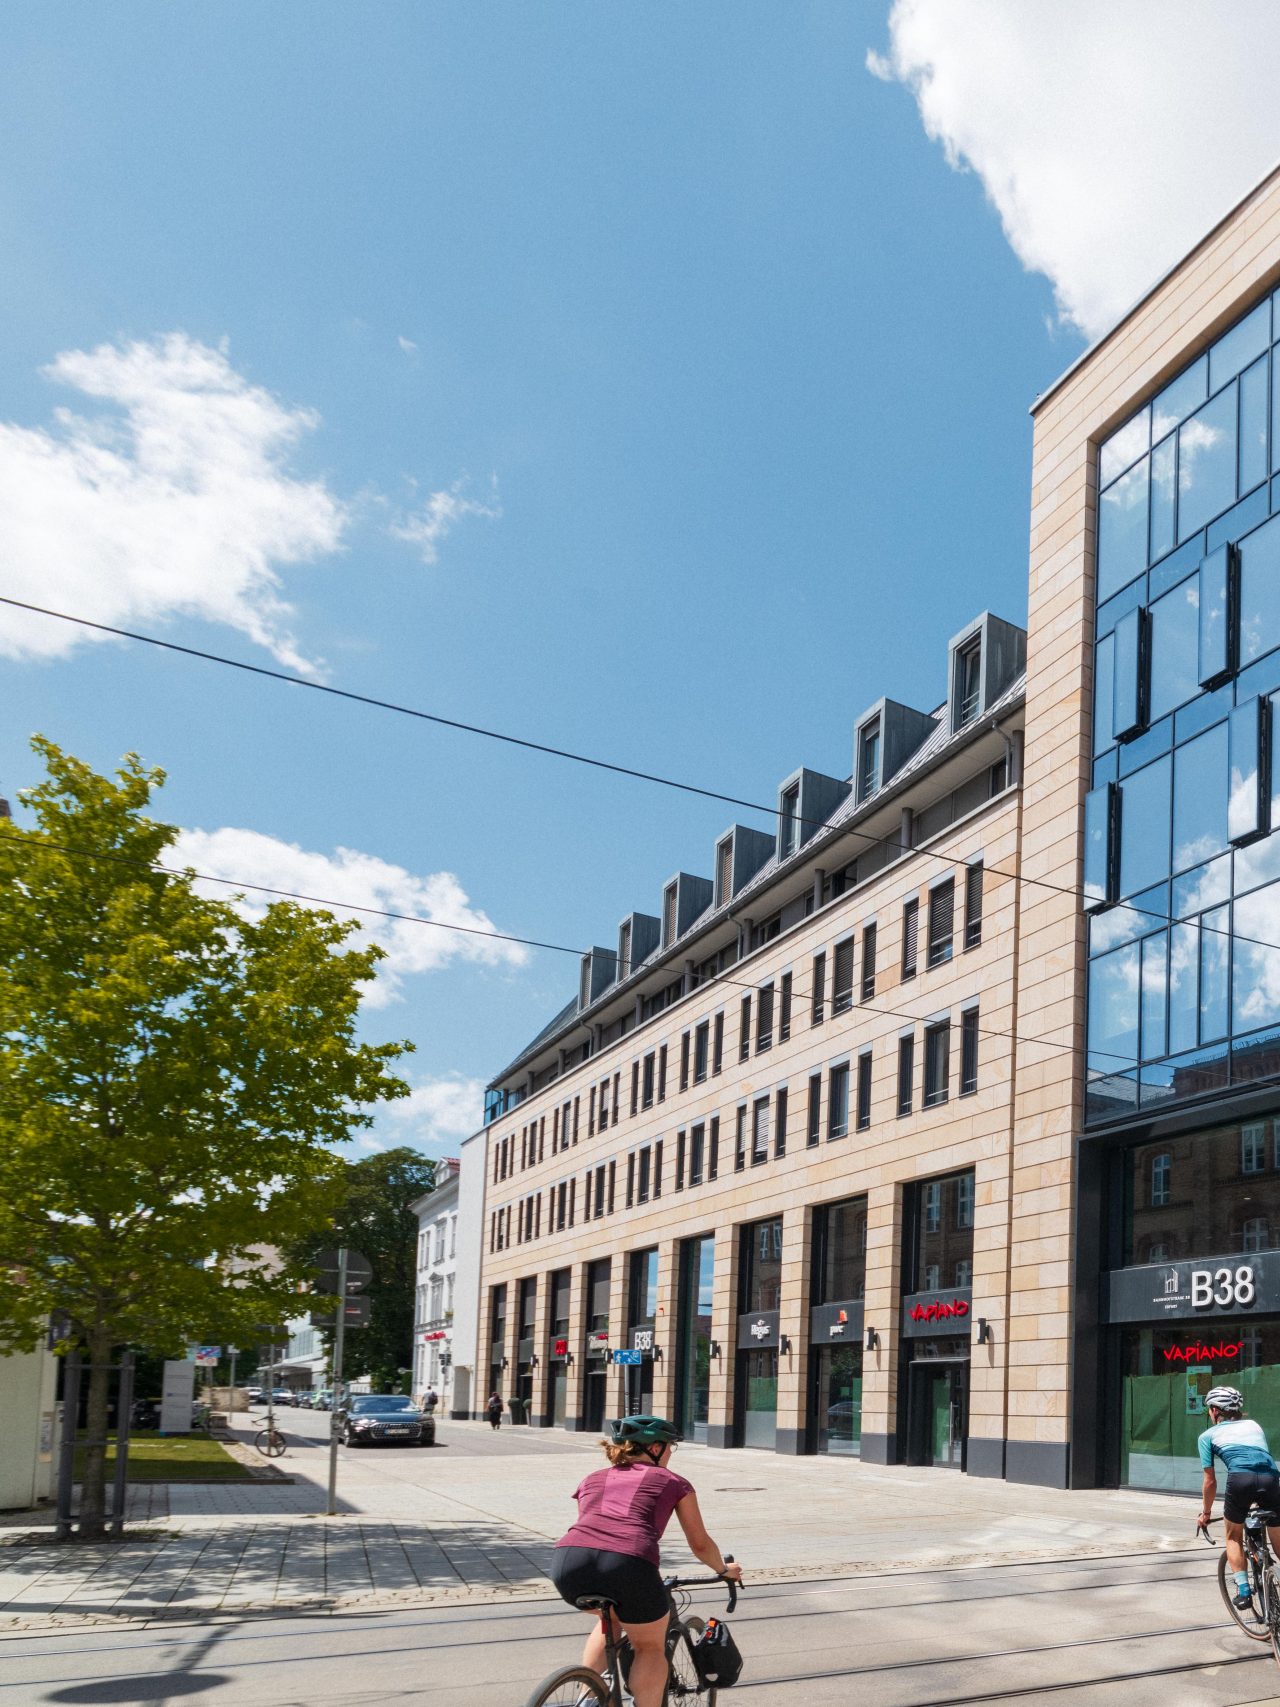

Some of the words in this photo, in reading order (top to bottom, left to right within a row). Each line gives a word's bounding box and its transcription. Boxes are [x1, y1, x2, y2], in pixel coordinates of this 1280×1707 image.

[1192, 1266, 1255, 1307] B38
[909, 1299, 968, 1323] VAPIANO
[635, 1331, 653, 1350] B38
[1163, 1341, 1239, 1363] VAPIANO
